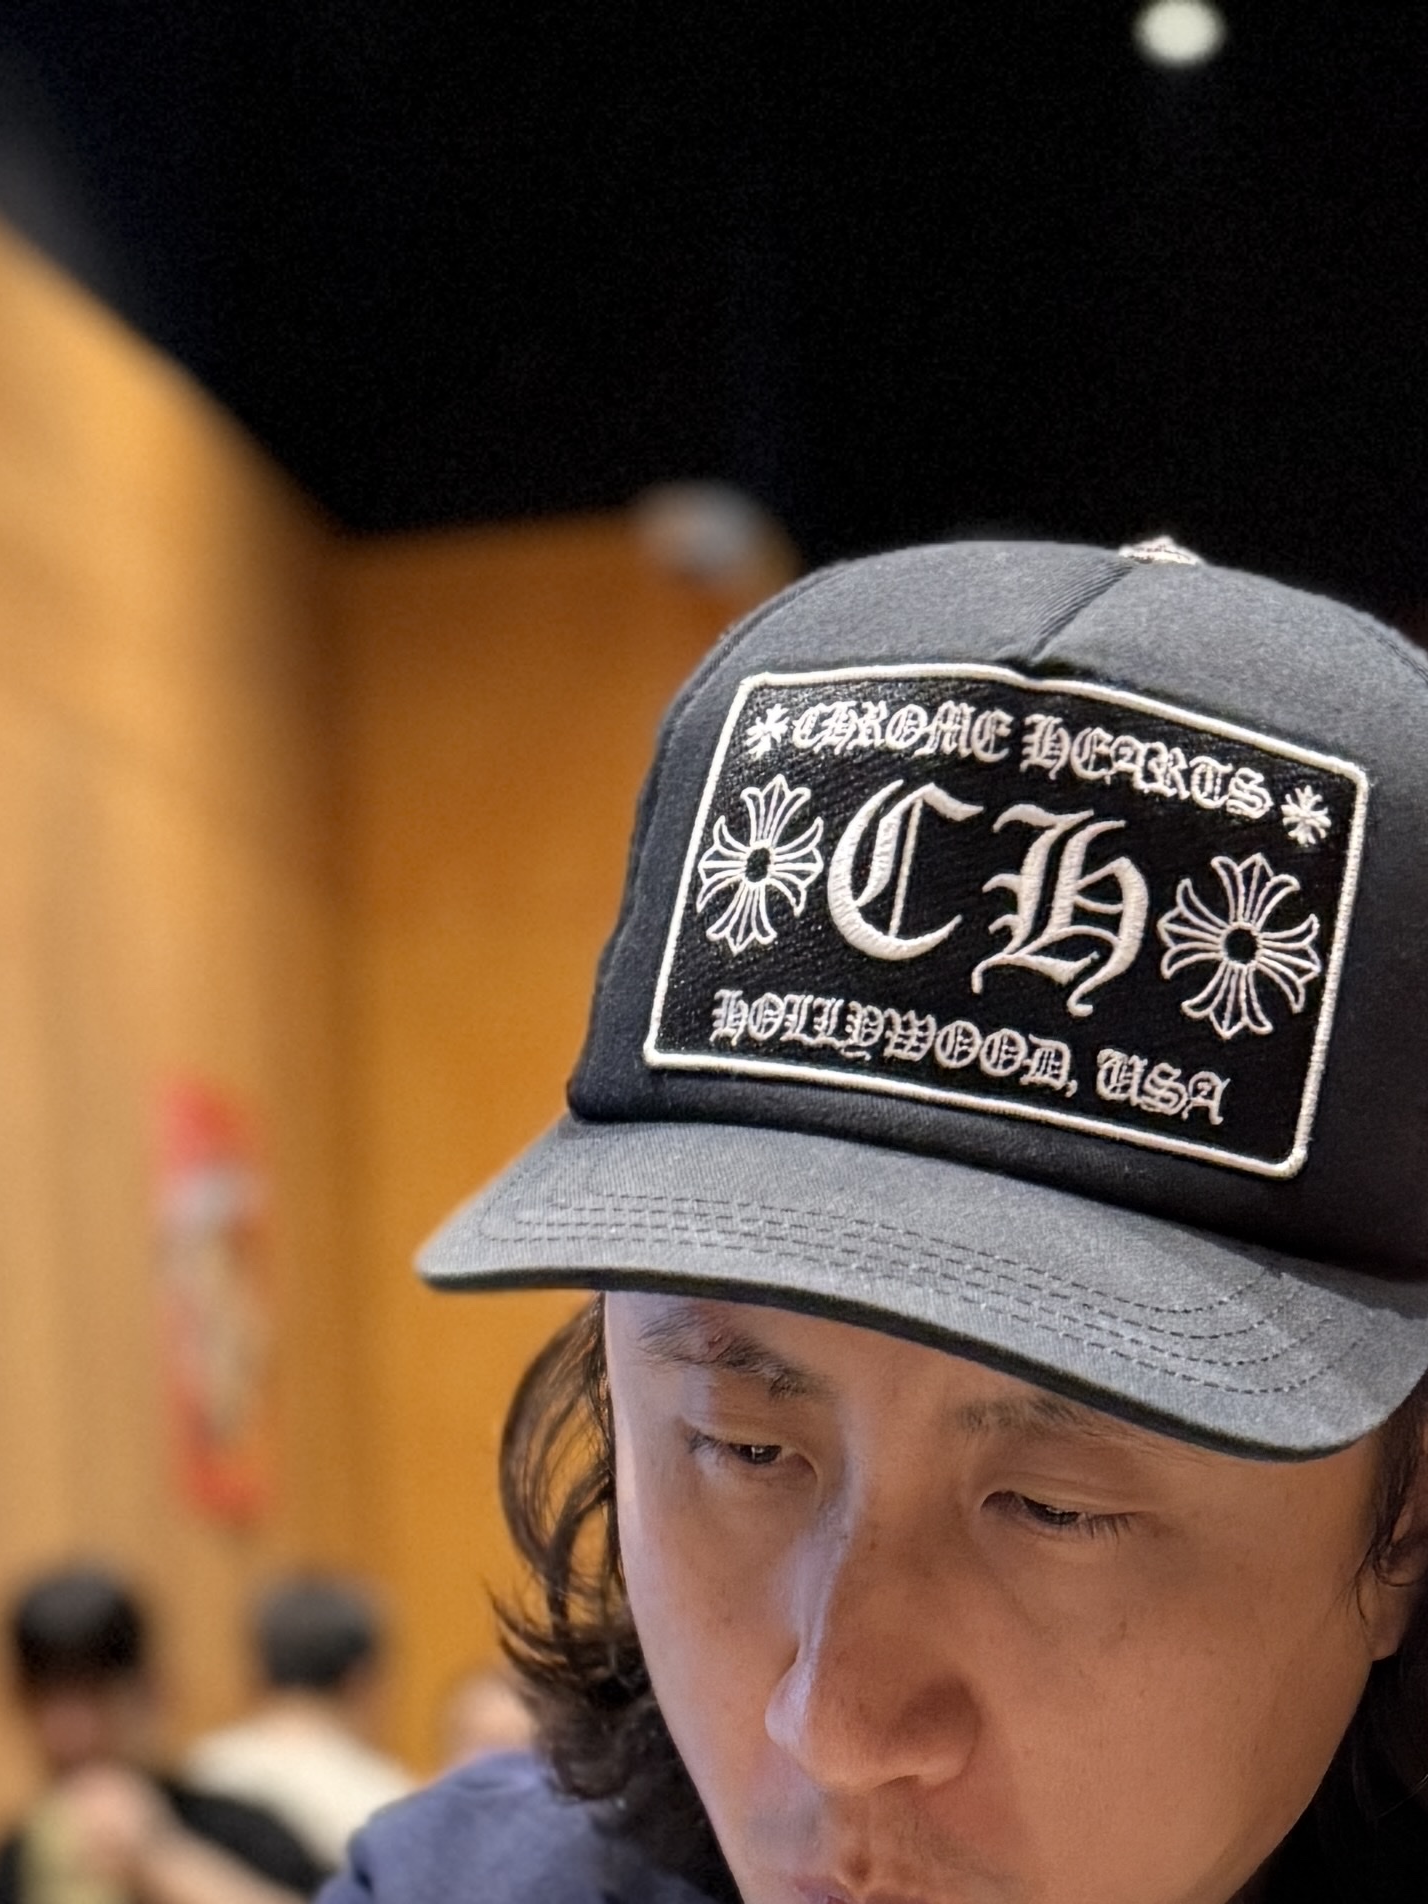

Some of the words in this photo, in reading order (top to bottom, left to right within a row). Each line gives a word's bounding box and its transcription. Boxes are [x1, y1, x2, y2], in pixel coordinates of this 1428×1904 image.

[792, 703, 1012, 763] CHROME
[1022, 714, 1272, 819] HEARTS
[710, 988, 1079, 1097] HOLLYWOOD,
[1096, 1048, 1232, 1127] USA
